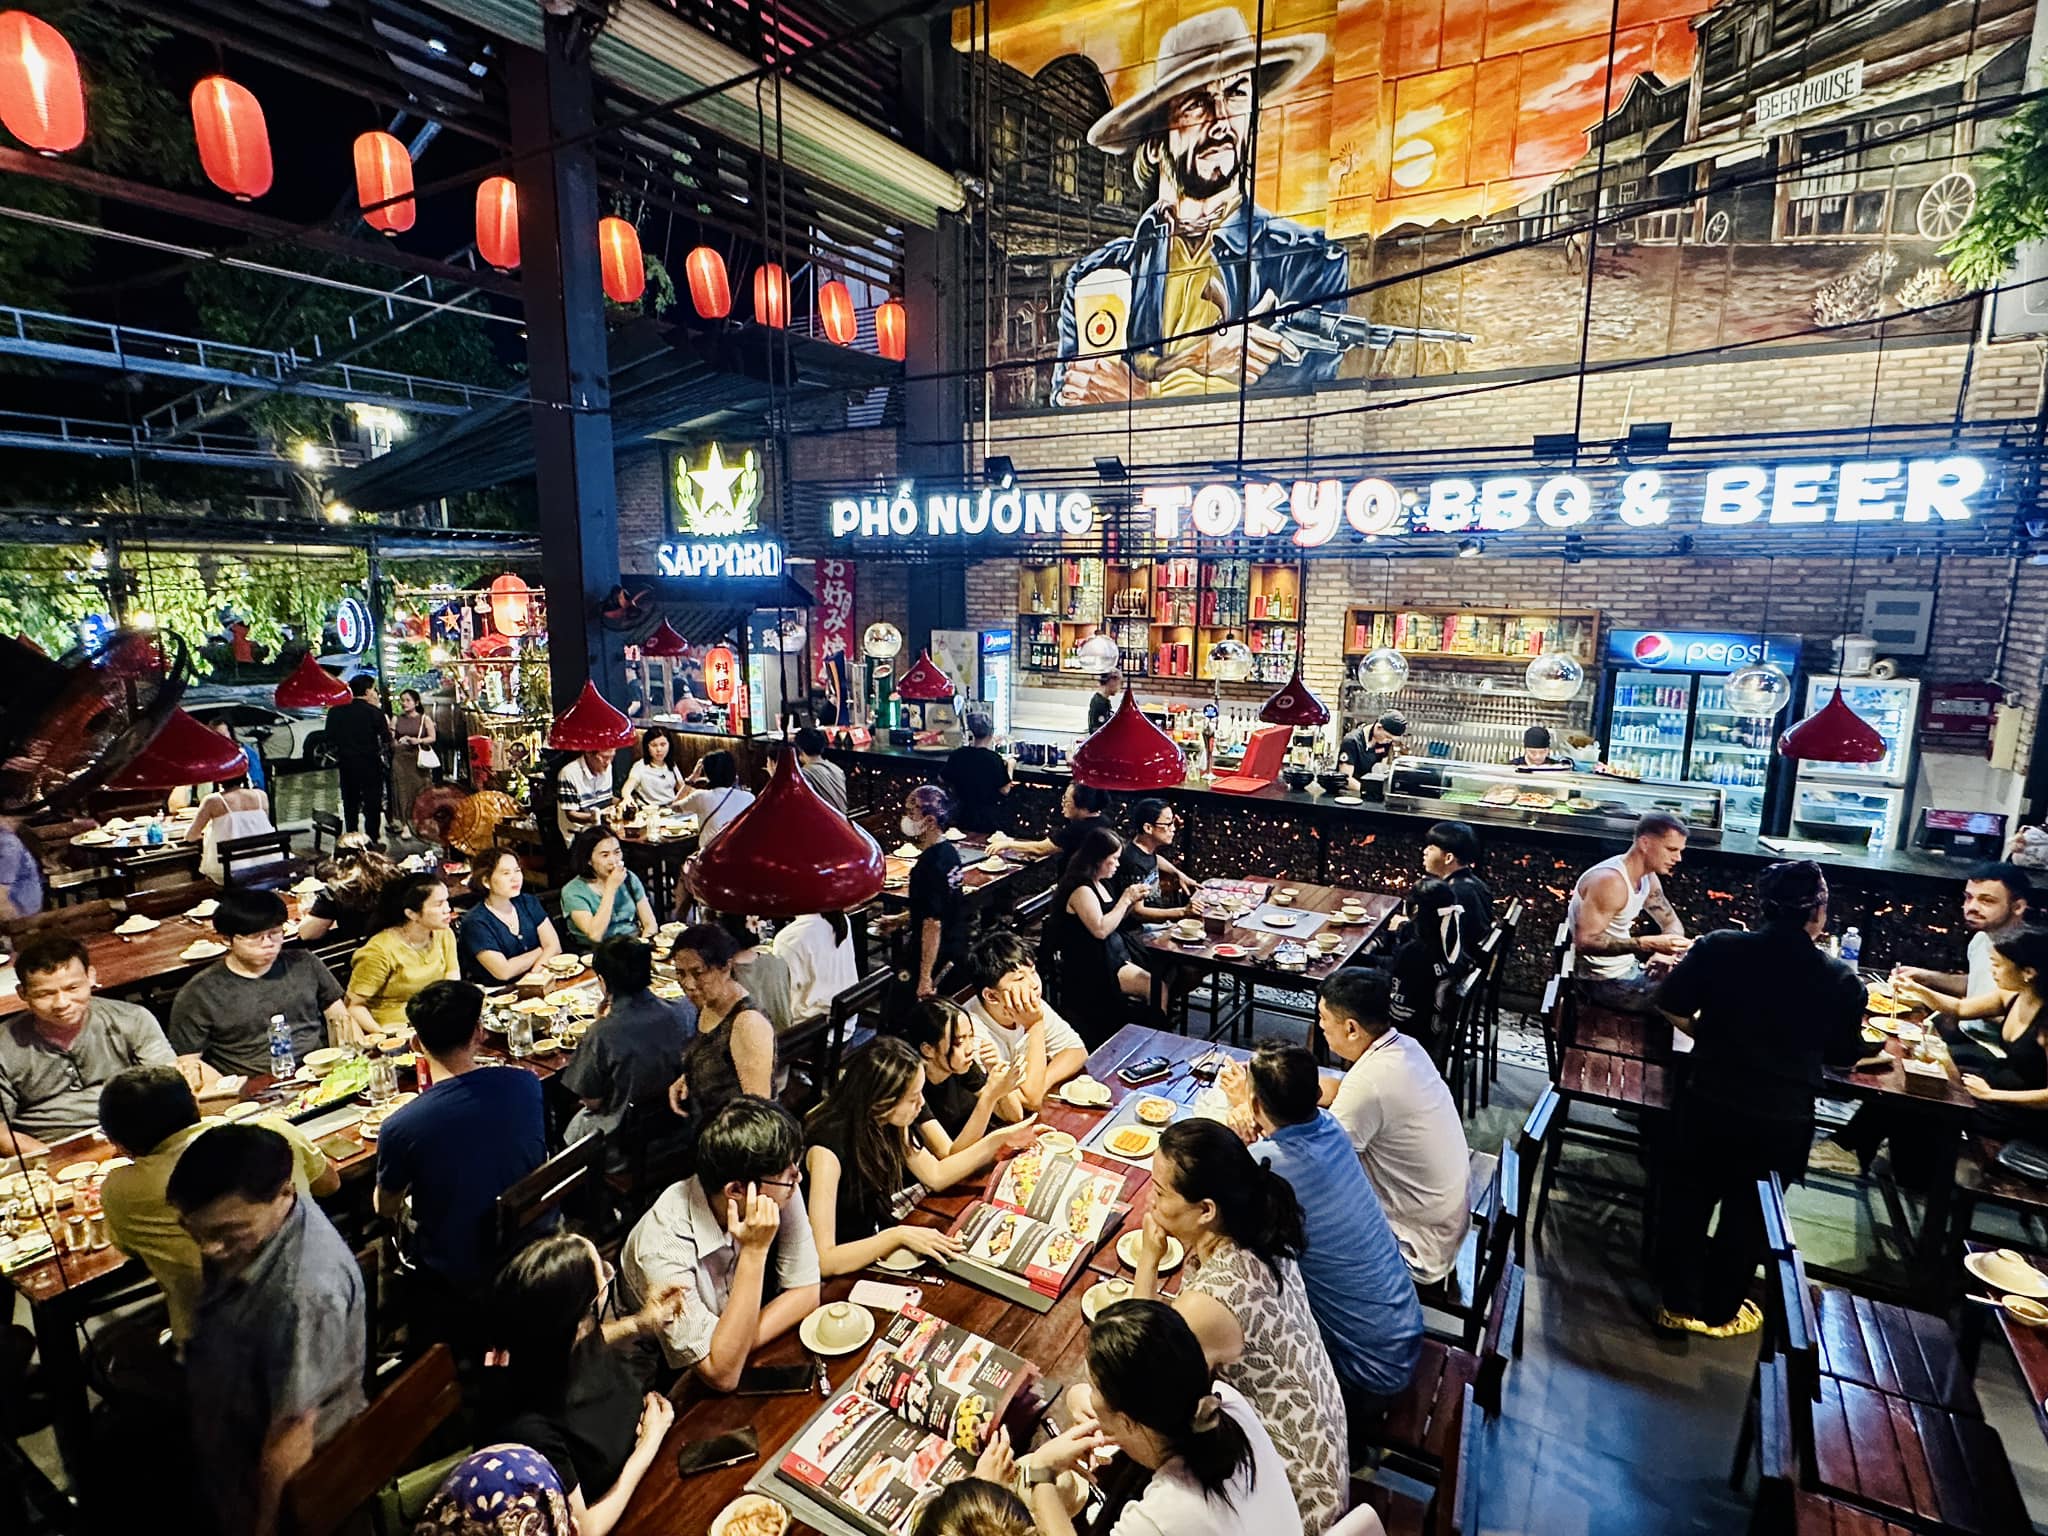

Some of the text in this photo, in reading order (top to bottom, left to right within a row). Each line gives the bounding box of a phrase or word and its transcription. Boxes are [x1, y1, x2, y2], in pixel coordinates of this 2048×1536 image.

[1803, 67, 1856, 107] HOUSE
[832, 478, 919, 537] PHỐ
[928, 474, 1094, 536] NƯỚNG
[1428, 474, 1593, 533] BBQ
[1619, 470, 1671, 527] &
[1701, 456, 1986, 525] BEER
[657, 542, 782, 577] SAPPORO
[1685, 640, 1770, 666] pepsi
